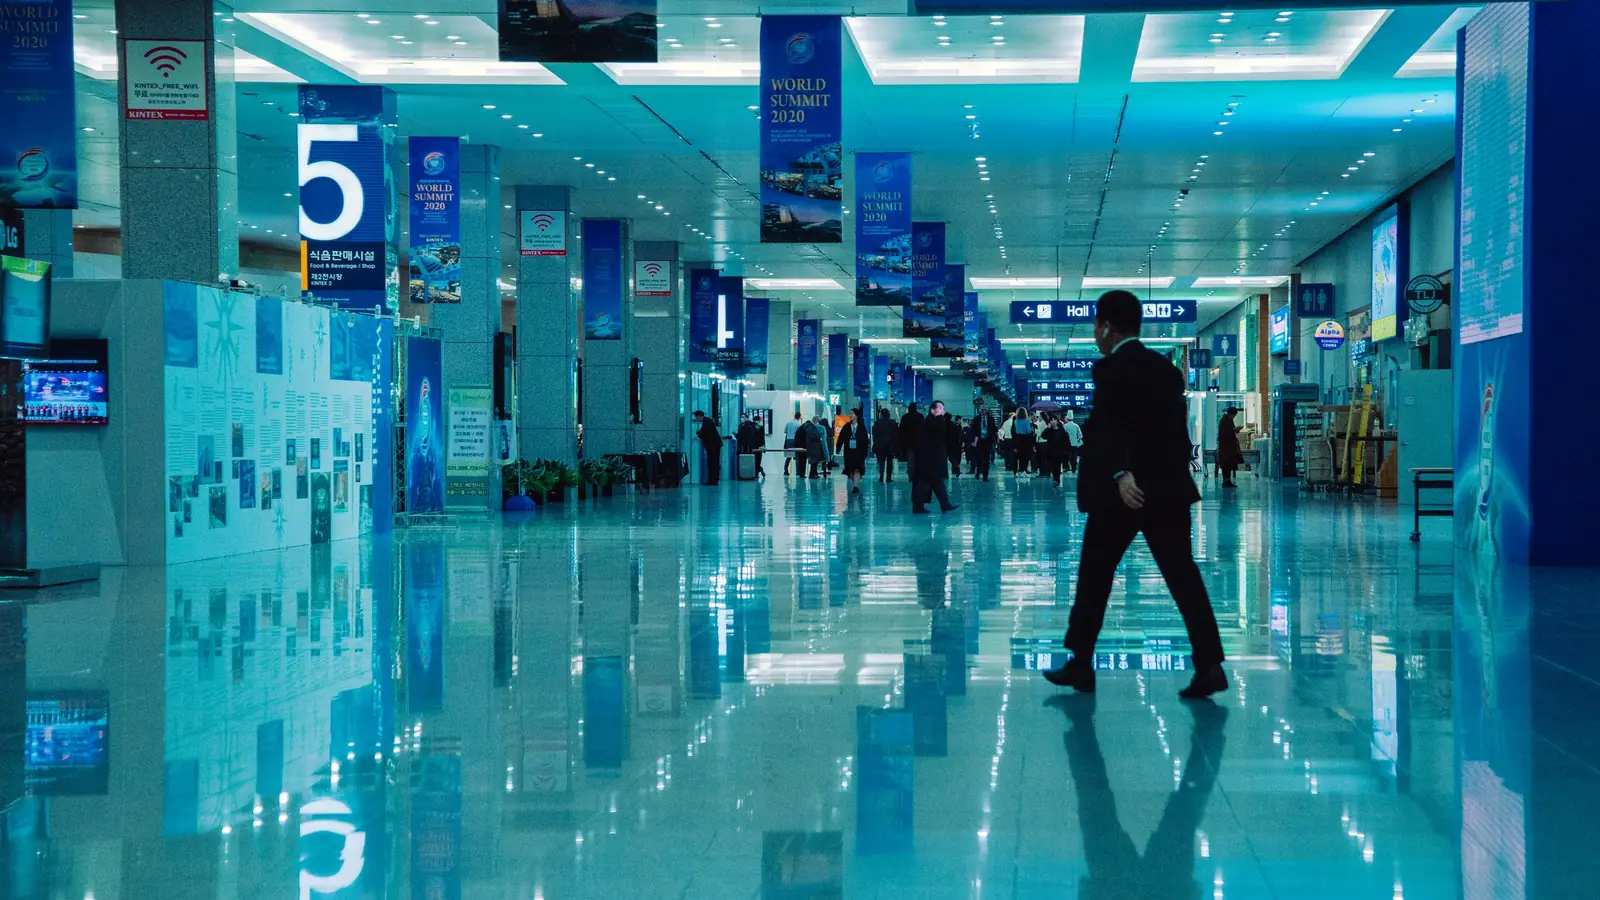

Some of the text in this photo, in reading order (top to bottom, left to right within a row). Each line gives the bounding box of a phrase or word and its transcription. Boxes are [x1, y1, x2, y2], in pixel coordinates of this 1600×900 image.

[13, 36, 48, 48] 2020
[770, 78, 826, 90] WORLD
[770, 94, 830, 107] SUMMIT
[770, 110, 805, 123] 2020
[297, 124, 364, 241] 5
[416, 184, 452, 192] WORLD
[414, 193, 454, 201] SUMMIT
[864, 192, 901, 200] WORLD
[863, 202, 903, 211] SUMMIT
[864, 213, 887, 222] 2020
[7, 226, 18, 248] LG
[310, 250, 374, 261] 식음판매시설
[1067, 306, 1089, 316] Hall
